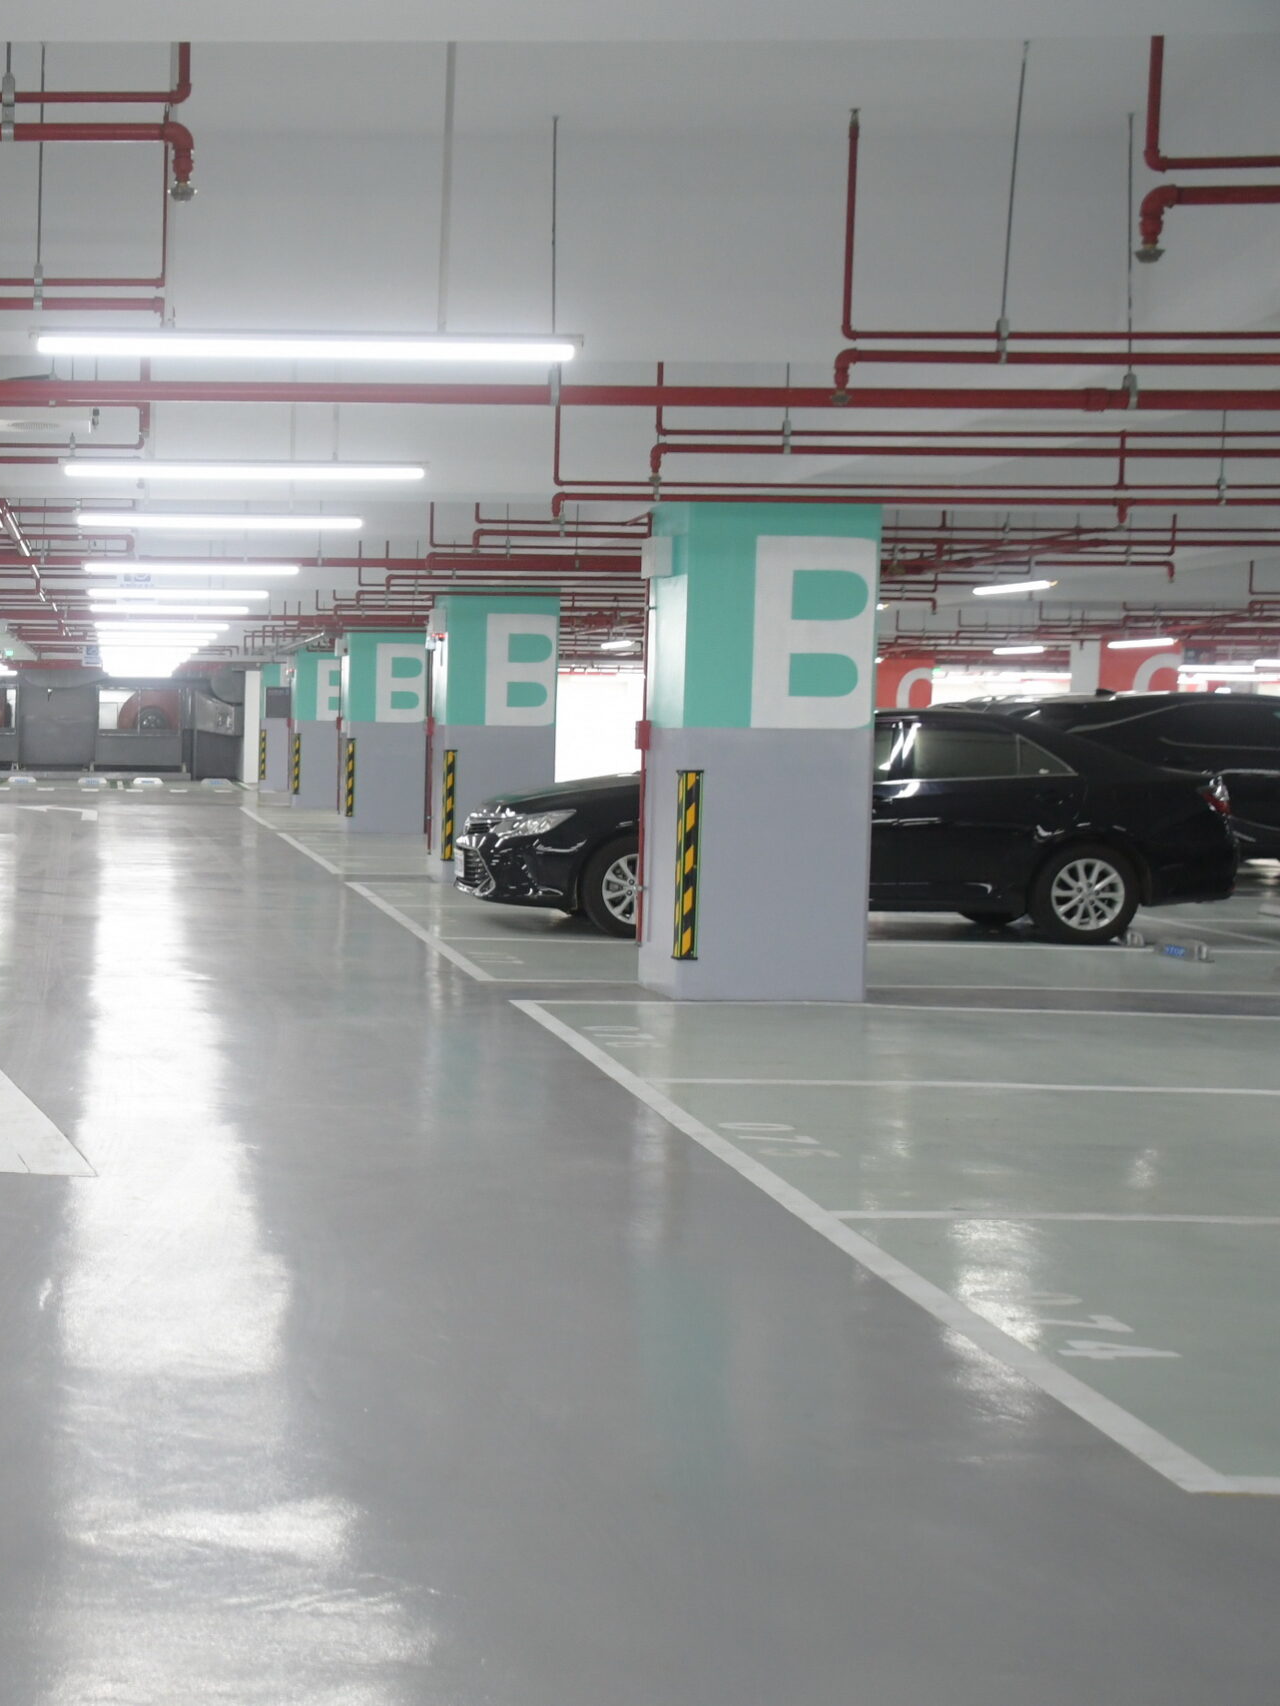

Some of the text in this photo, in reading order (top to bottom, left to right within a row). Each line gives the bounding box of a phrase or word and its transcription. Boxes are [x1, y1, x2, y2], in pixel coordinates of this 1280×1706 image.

[376, 643, 425, 722] B
[485, 613, 557, 726] B
[751, 535, 877, 729] B
